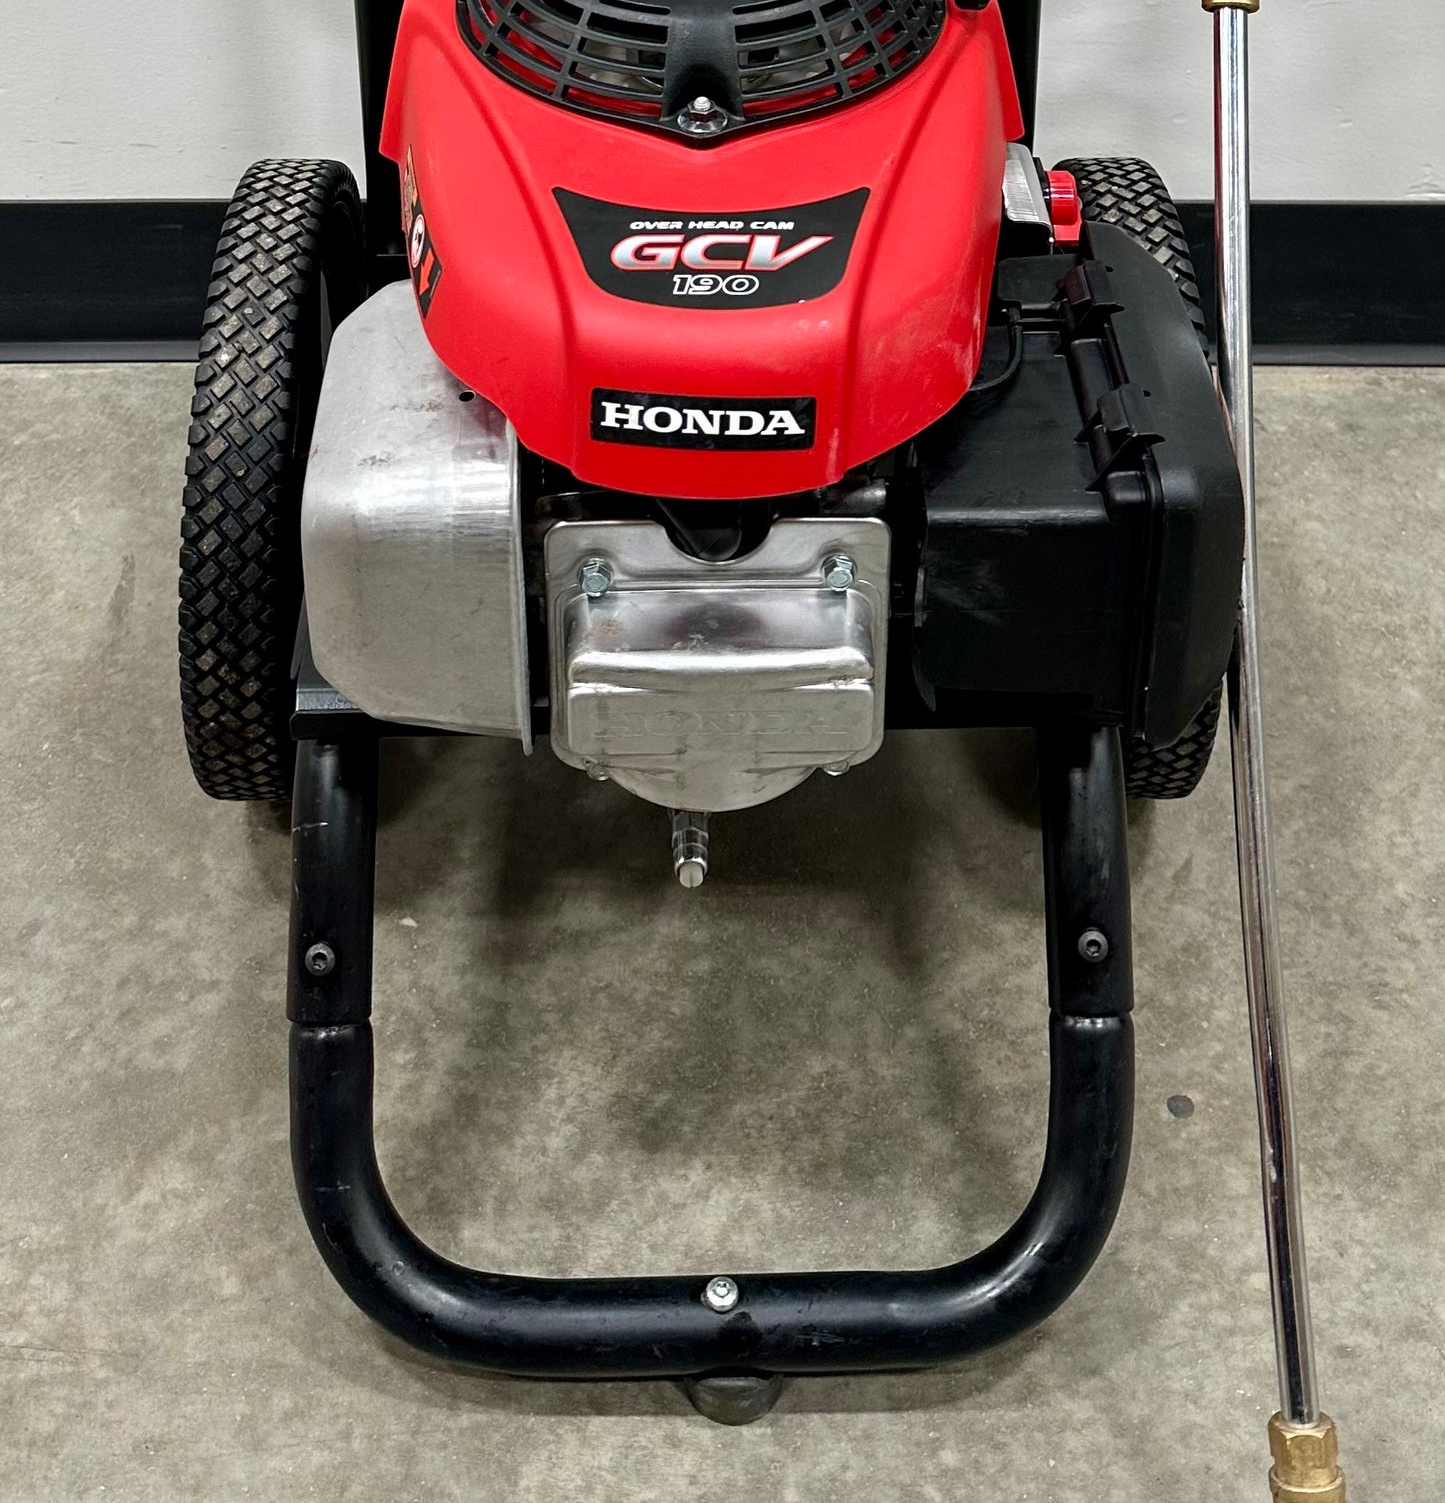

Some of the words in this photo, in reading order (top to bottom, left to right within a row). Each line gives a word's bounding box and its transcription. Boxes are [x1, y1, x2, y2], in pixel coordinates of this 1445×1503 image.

[630, 221, 684, 230] OVER
[688, 220, 744, 230] HEAD
[750, 221, 794, 230] CAM
[610, 233, 834, 271] GCV
[672, 274, 760, 296] 190
[600, 401, 805, 436] HONDA
